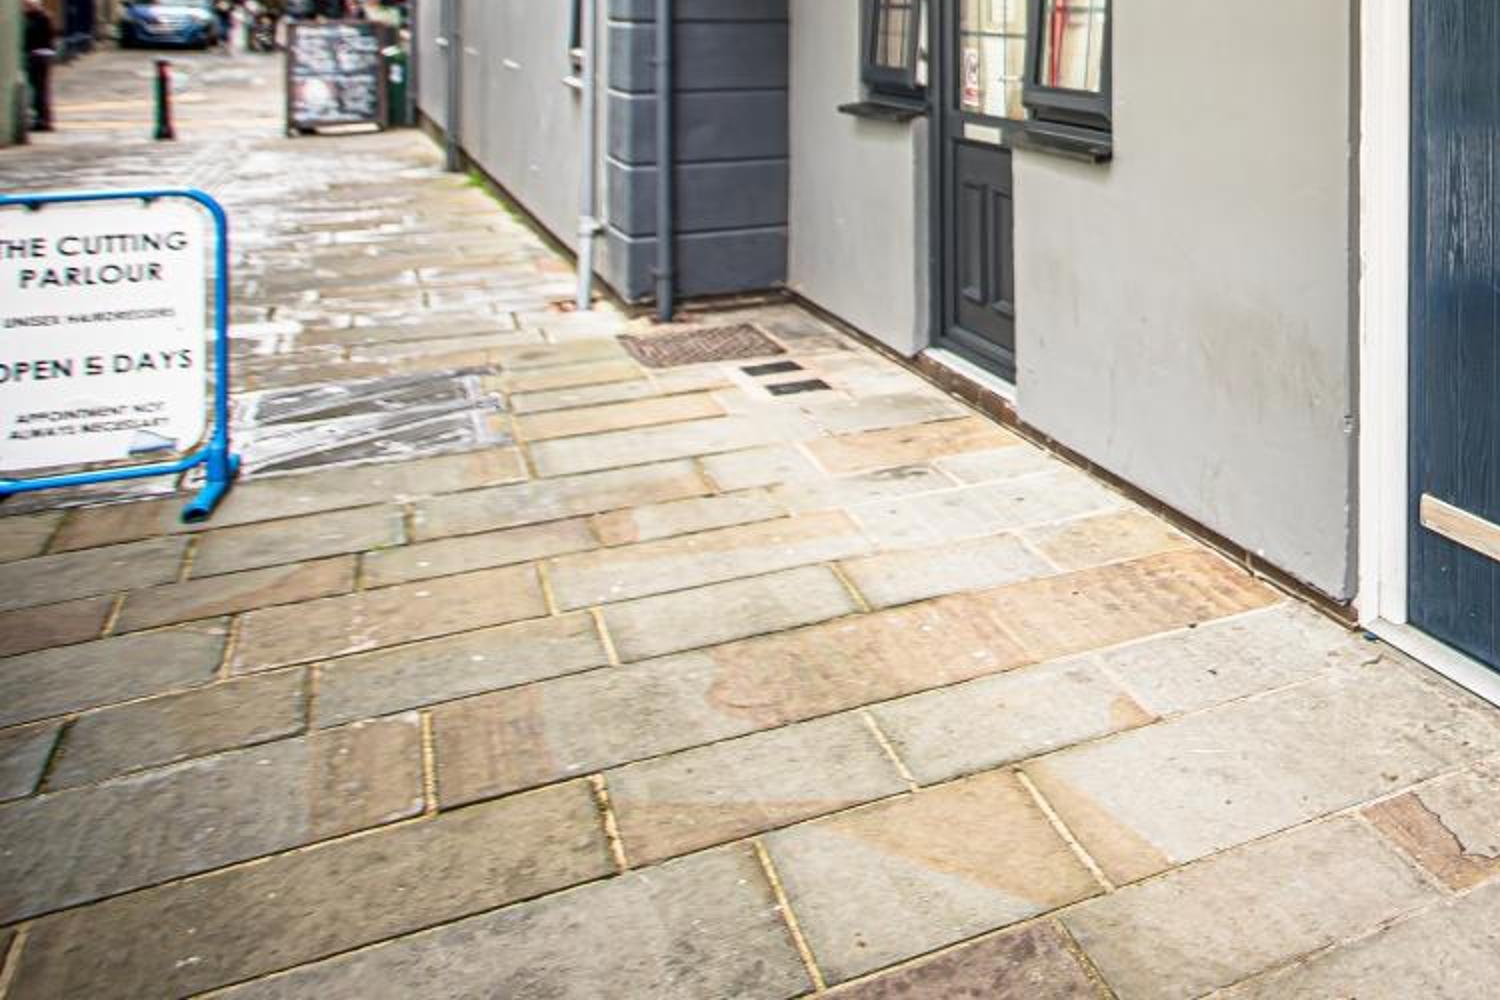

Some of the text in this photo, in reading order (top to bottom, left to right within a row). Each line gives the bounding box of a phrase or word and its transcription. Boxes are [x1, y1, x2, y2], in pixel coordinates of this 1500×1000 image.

[57, 231, 188, 257] CUTTING
[19, 263, 164, 289] PARLOUR
[85, 356, 104, 376] 5
[113, 349, 194, 375] DAYS
